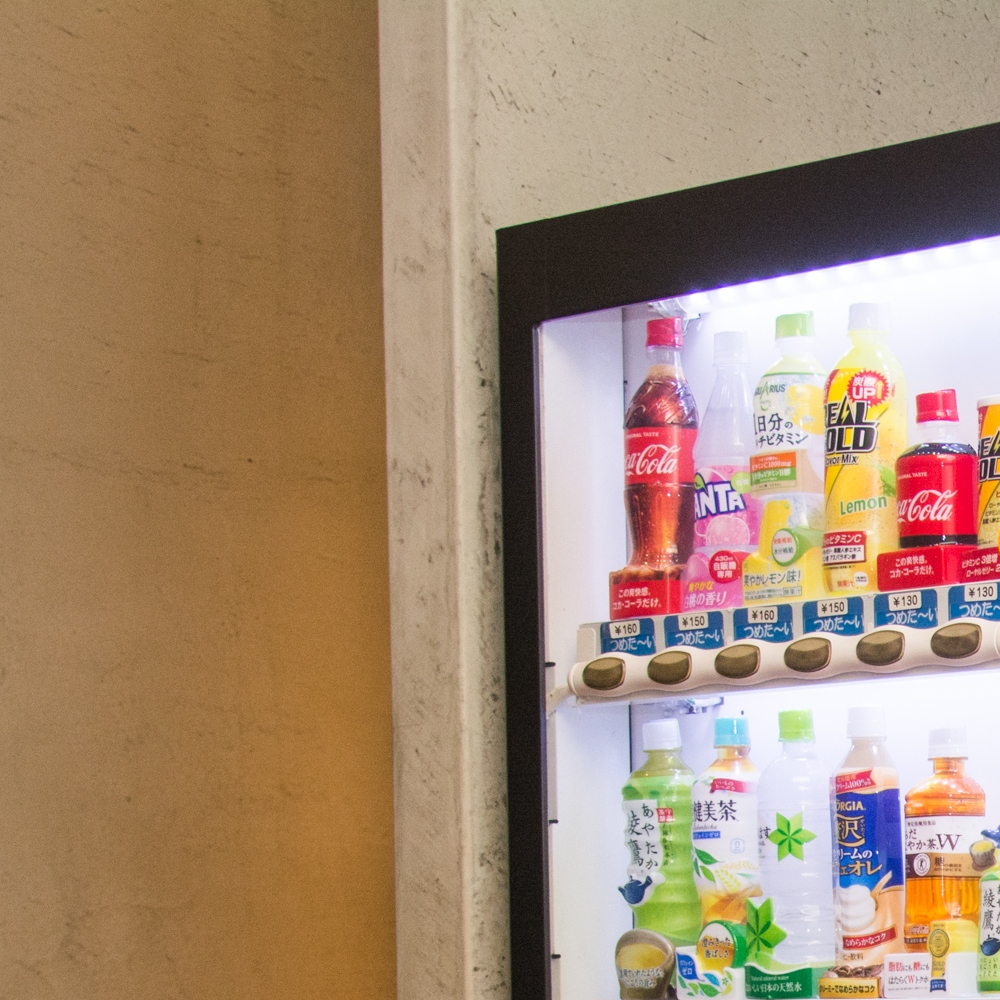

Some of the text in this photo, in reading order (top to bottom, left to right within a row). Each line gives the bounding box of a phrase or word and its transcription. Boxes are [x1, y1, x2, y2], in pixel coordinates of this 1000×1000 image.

[852, 386, 876, 400] UP
[694, 481, 746, 519] ANTA
[840, 496, 888, 516] Lemon
[889, 565, 935, 579] コカ・コーラだけ。
[968, 586, 994, 599] ¥130
[612, 598, 662, 611] コカ・コーラだけ。
[893, 594, 918, 607] ¥130
[751, 608, 776, 621] ¥160
[821, 602, 846, 614] ¥150
[682, 615, 705, 627] ¥150
[614, 622, 638, 636] ¥160
[642, 803, 659, 870] あやたか
[982, 889, 995, 931] 綾鷹
[845, 932, 888, 949] なめらかなコク
[704, 949, 730, 960] 香ばしさ
[681, 967, 693, 976] ゼロ
